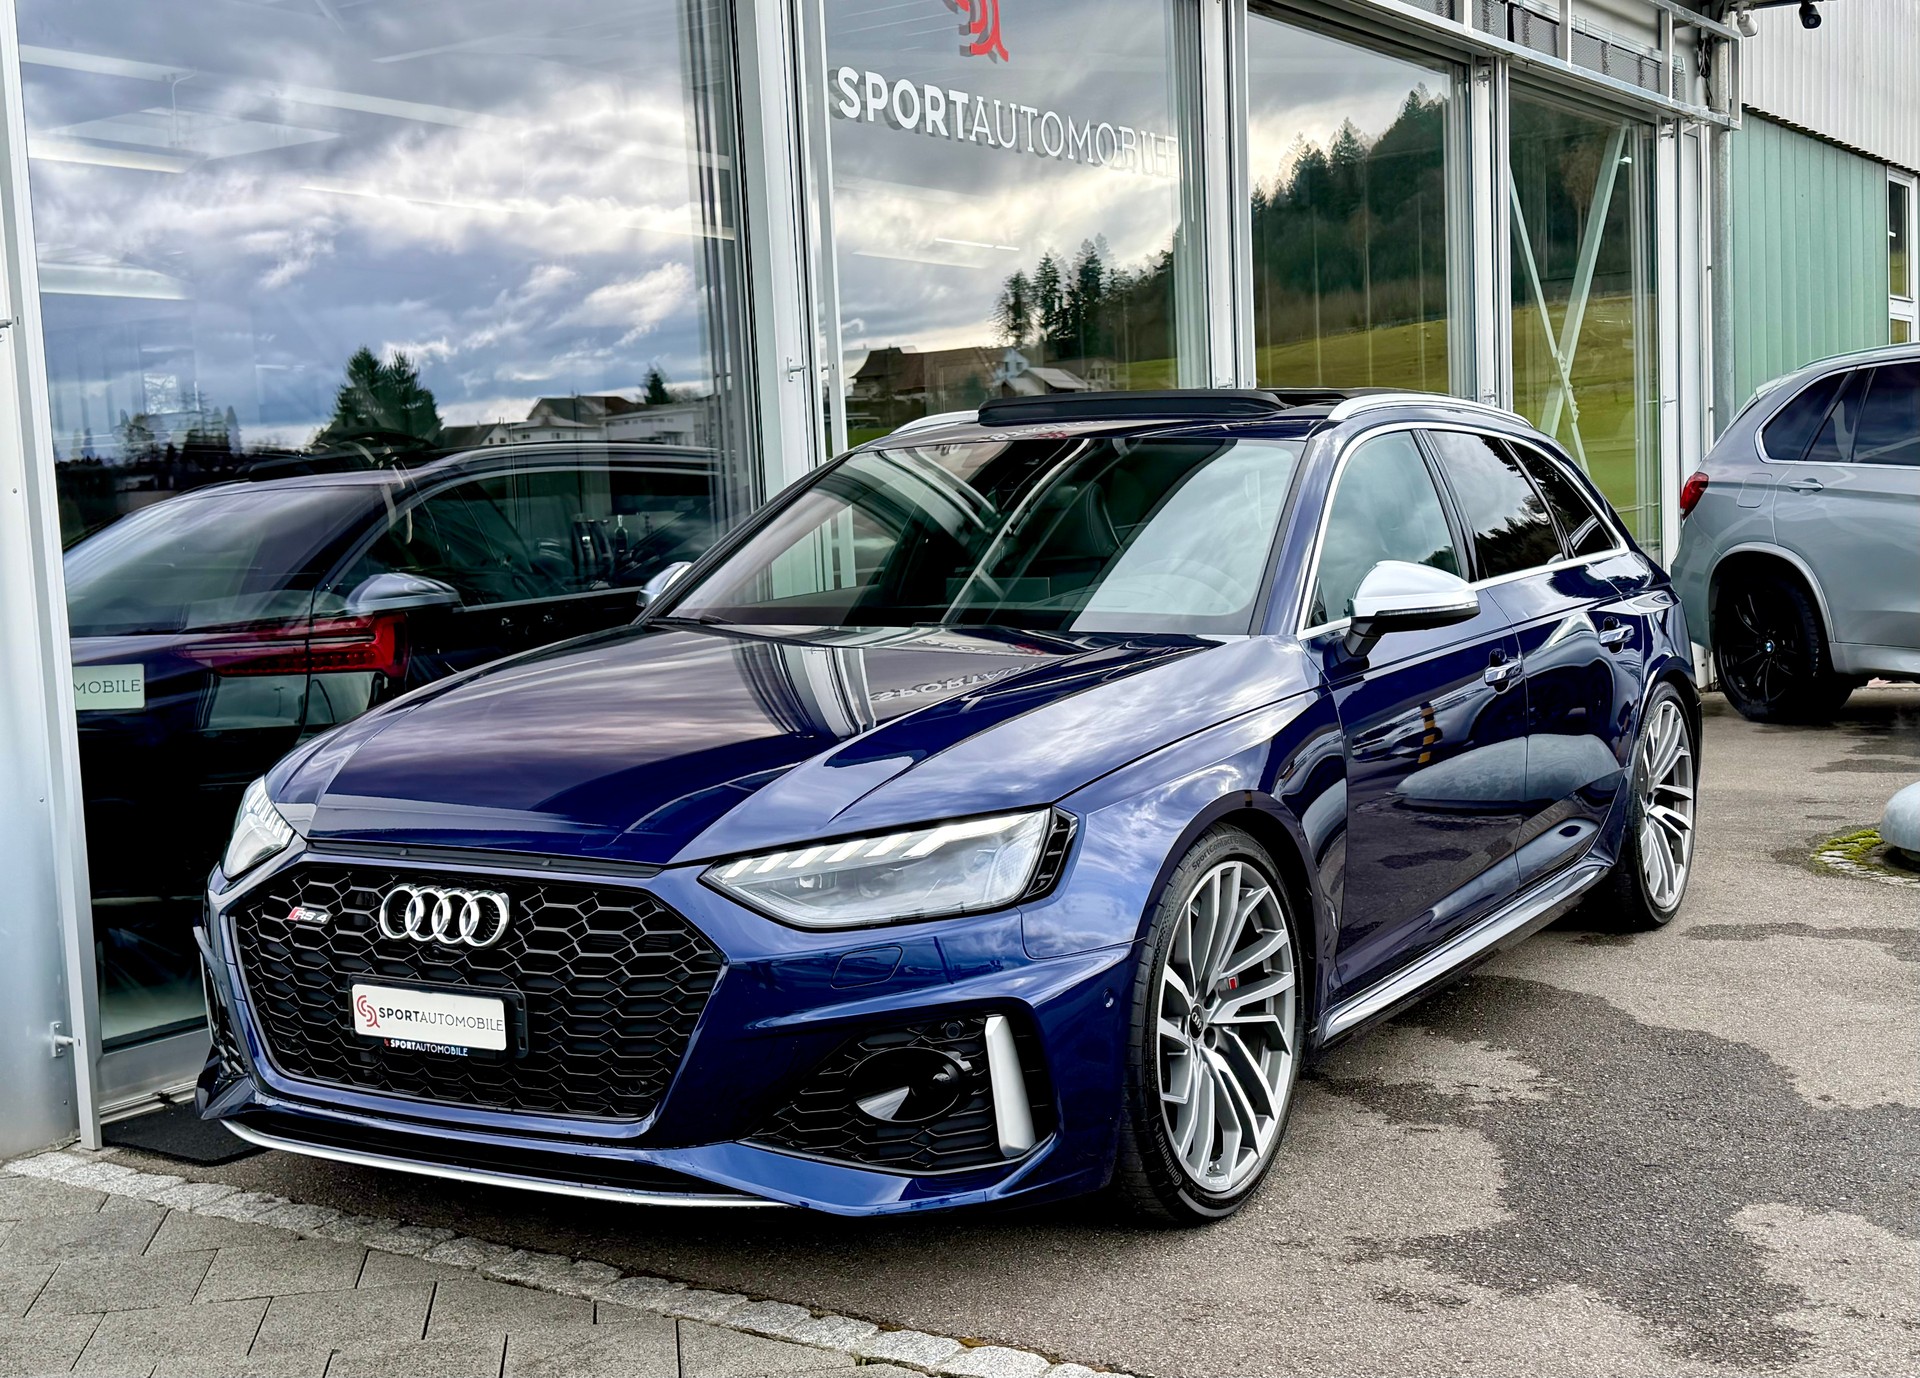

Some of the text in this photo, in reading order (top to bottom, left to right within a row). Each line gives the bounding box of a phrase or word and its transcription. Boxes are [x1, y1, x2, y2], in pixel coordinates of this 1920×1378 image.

[837, 66, 1179, 176] SPORTAUTOMOBILE
[378, 1007, 504, 1032] SPORTAUTOMOBILE
[390, 1039, 468, 1056] SPORTAUTOMOBILE
